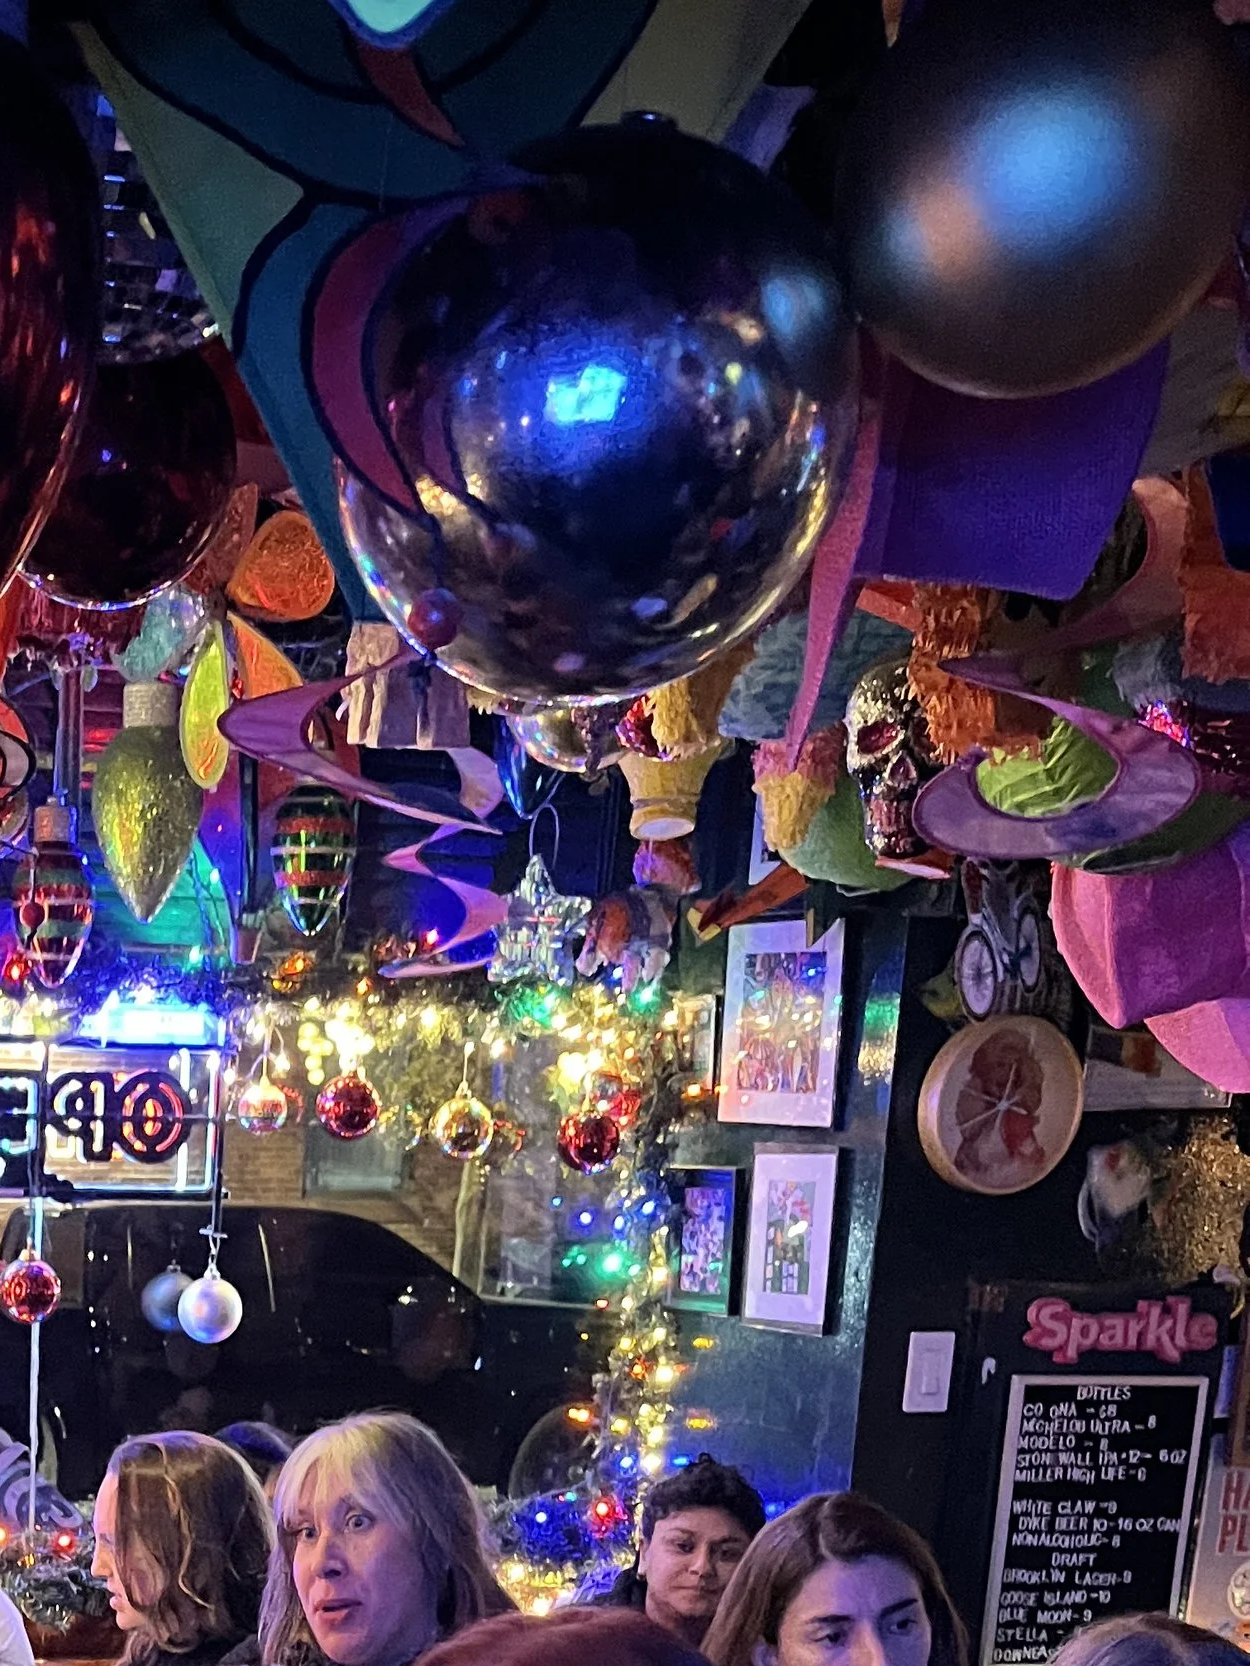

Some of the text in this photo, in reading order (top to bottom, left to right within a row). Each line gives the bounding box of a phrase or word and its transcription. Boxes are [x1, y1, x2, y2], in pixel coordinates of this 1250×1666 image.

[1023, 1296, 1218, 1364] Sparkle
[1076, 1385, 1131, 1400] BOTTLES
[1019, 1435, 1075, 1450] MODELO
[1014, 1467, 1063, 1483] MILLER
[1101, 1466, 1126, 1483] LIFE
[1012, 1499, 1052, 1517] WHITE
[1058, 1499, 1096, 1515] CLAW
[1018, 1516, 1050, 1531] DYKE
[1051, 1552, 1097, 1567] DRAFT
[999, 1606, 1029, 1624] BLUE
[996, 1627, 1048, 1643] STELLA
